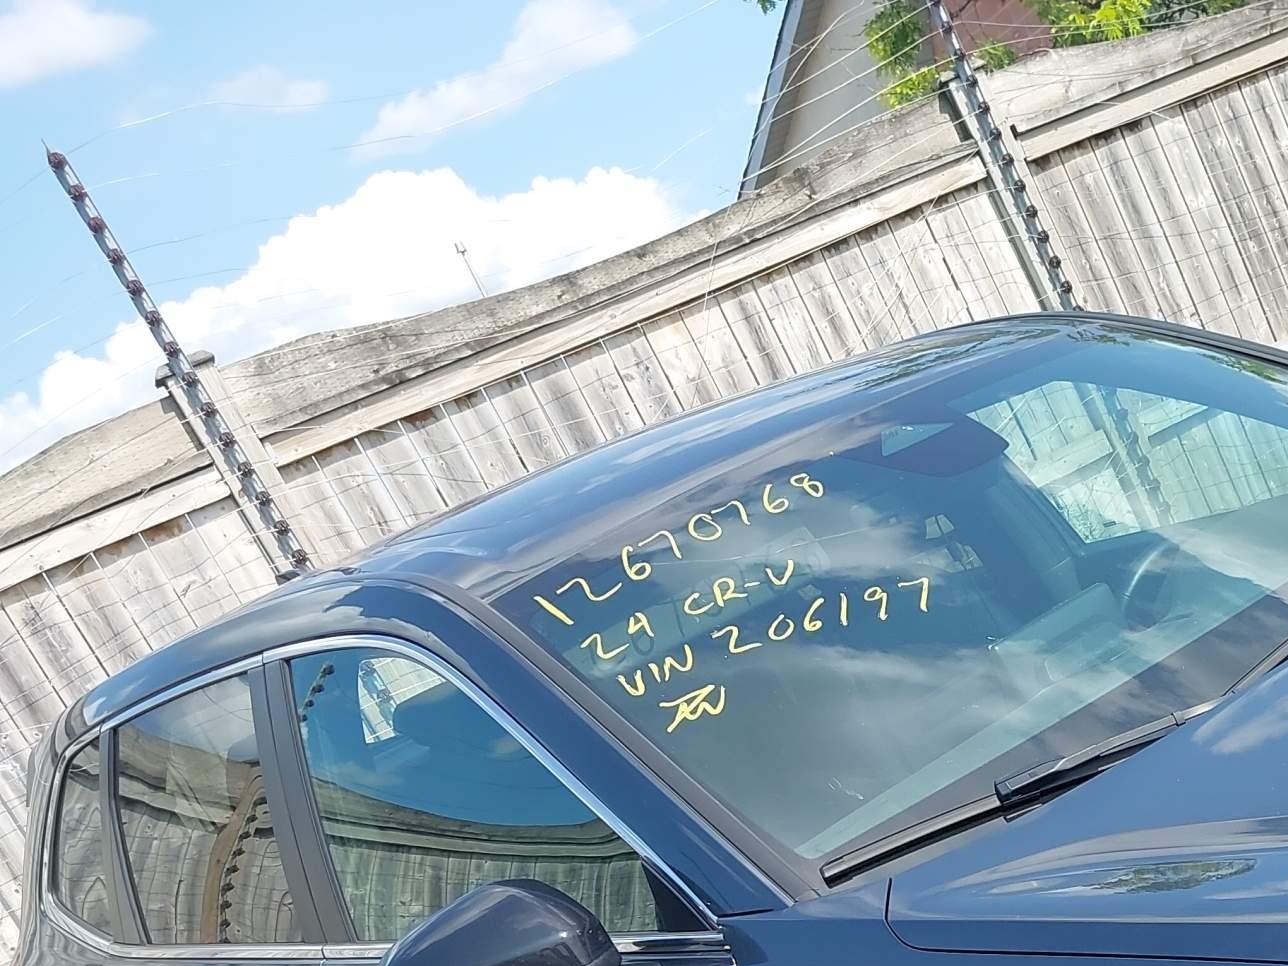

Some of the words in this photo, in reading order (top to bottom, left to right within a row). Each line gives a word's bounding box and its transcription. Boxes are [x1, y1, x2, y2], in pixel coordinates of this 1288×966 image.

[534, 473, 825, 626] 12670768
[580, 612, 655, 660] 24
[683, 558, 796, 617] CR-V
[616, 644, 694, 697] VIN
[711, 576, 930, 654] 206197
